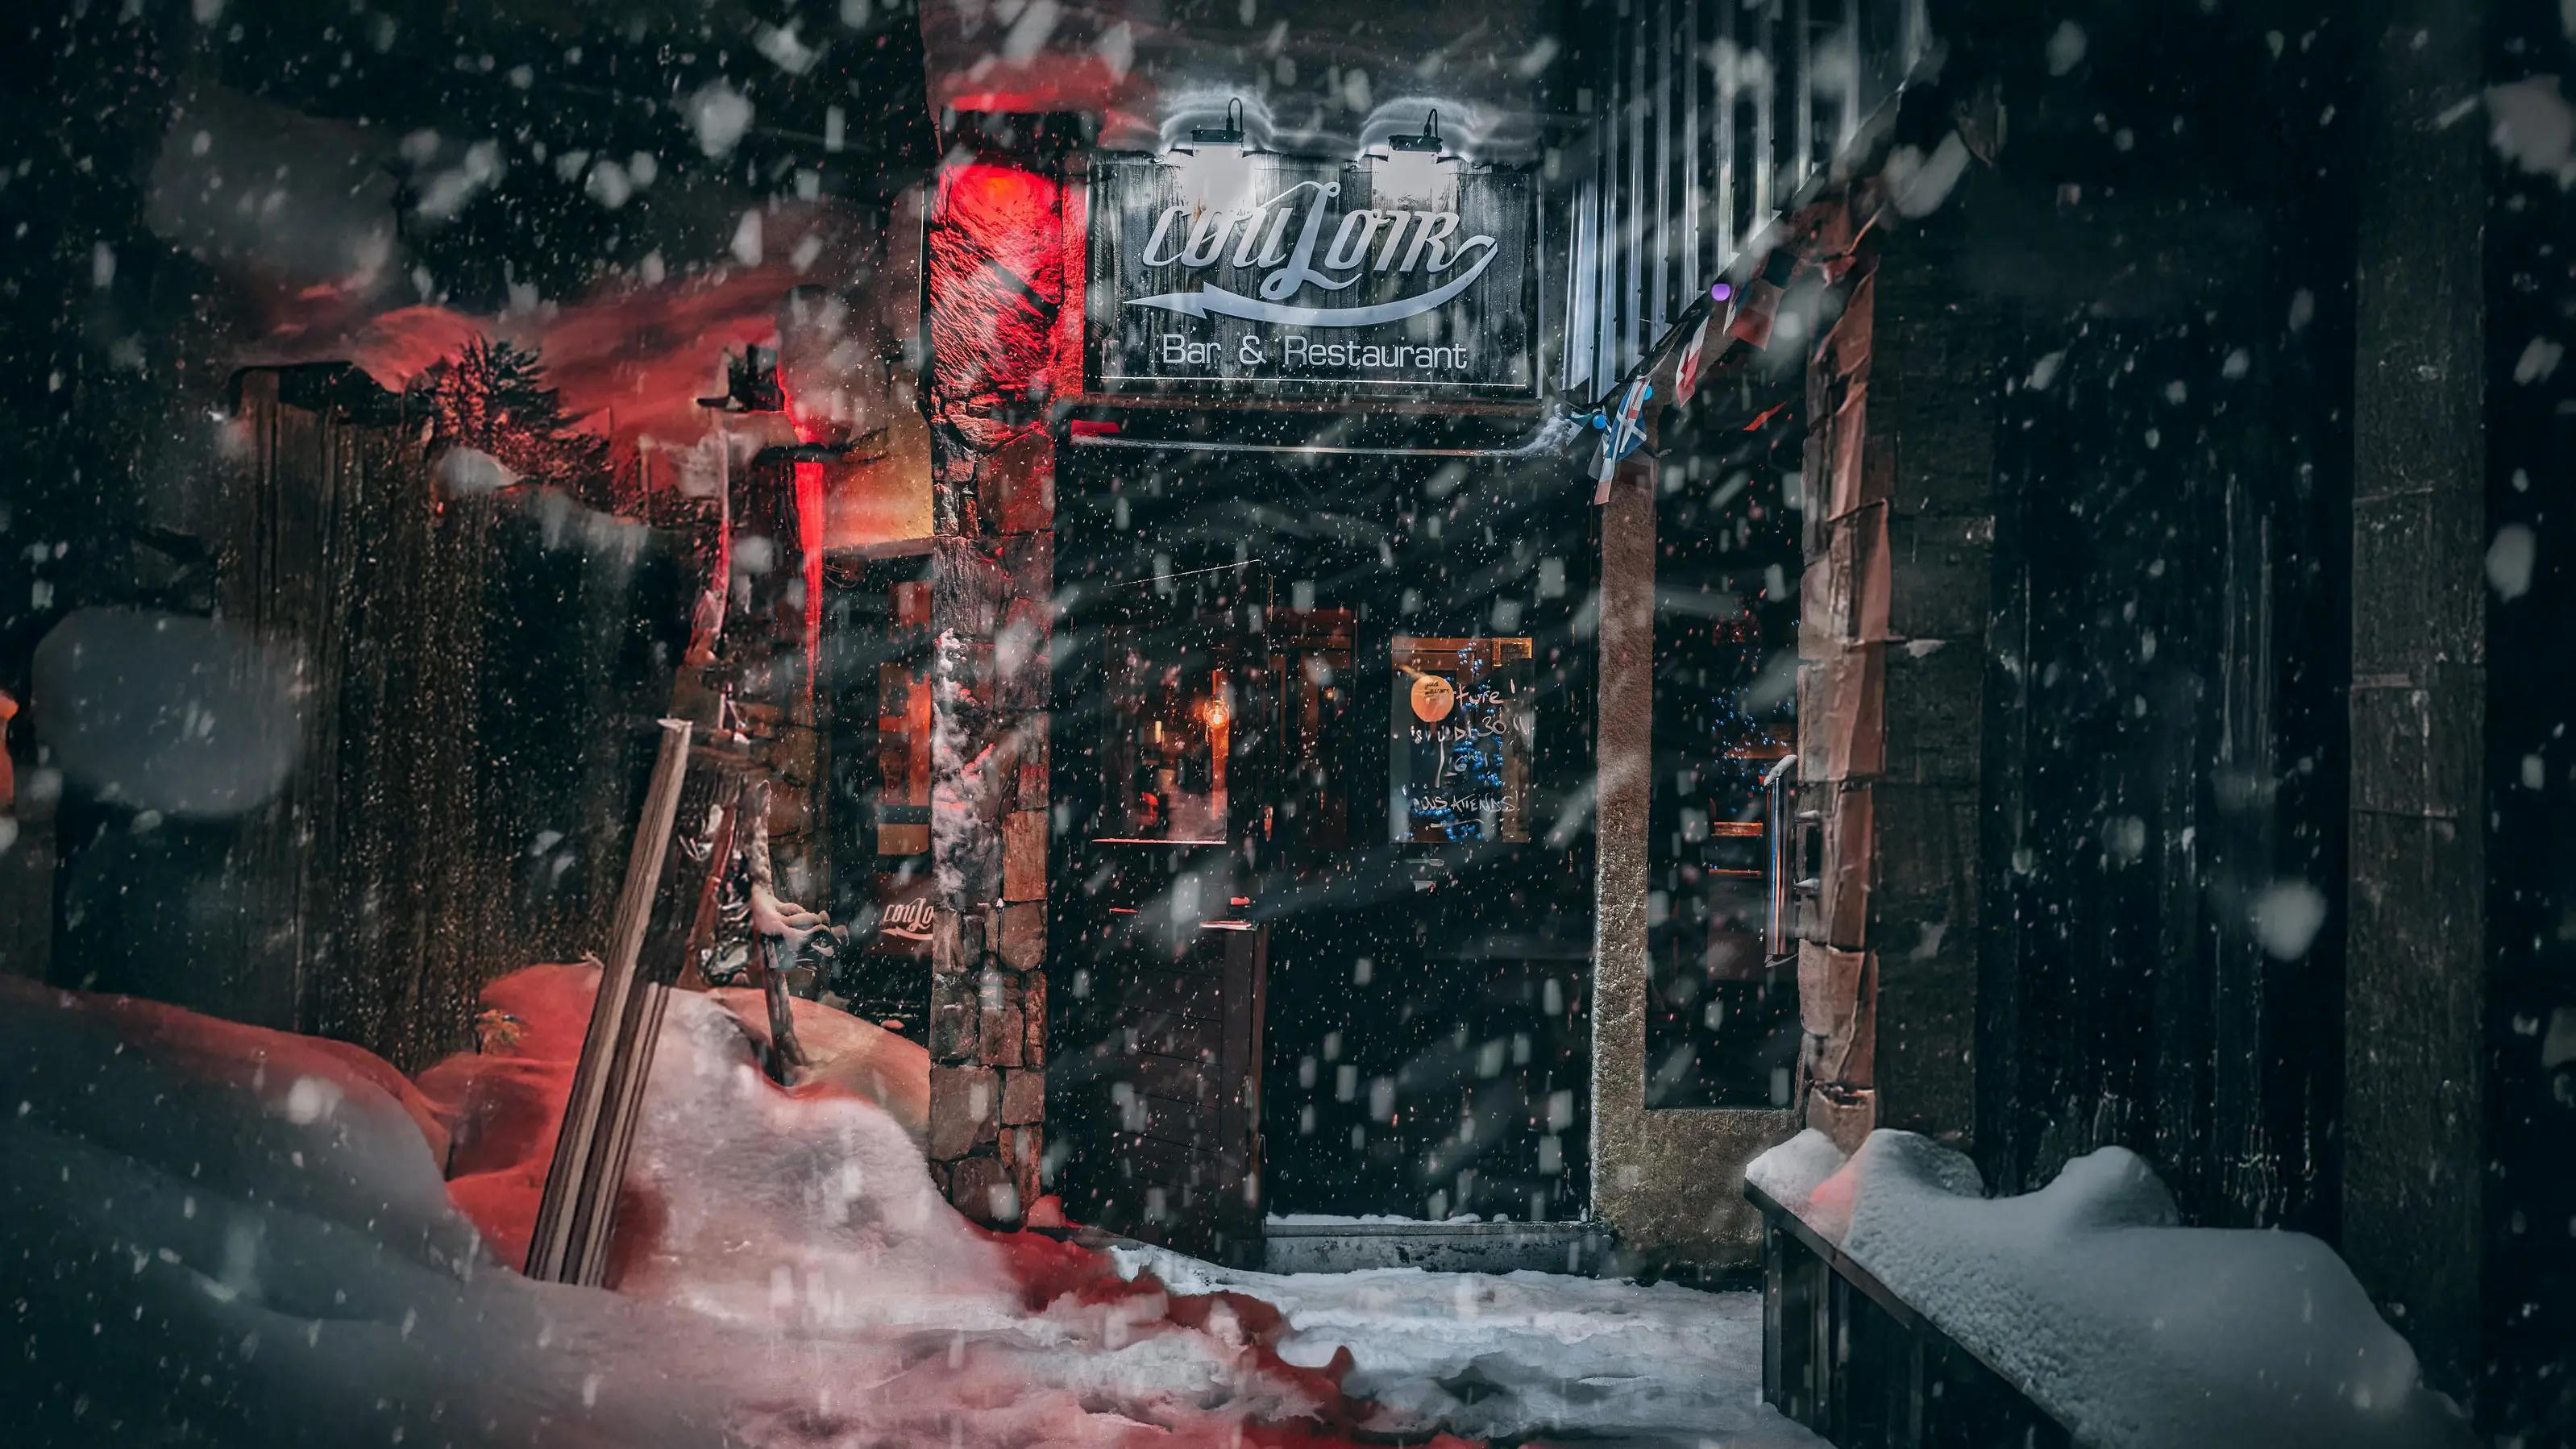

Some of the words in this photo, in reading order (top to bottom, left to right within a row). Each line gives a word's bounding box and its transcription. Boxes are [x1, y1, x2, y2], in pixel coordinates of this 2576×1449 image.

[1163, 334, 1221, 363] Bar
[1239, 335, 1266, 365] &
[1284, 335, 1468, 369] Restaurant
